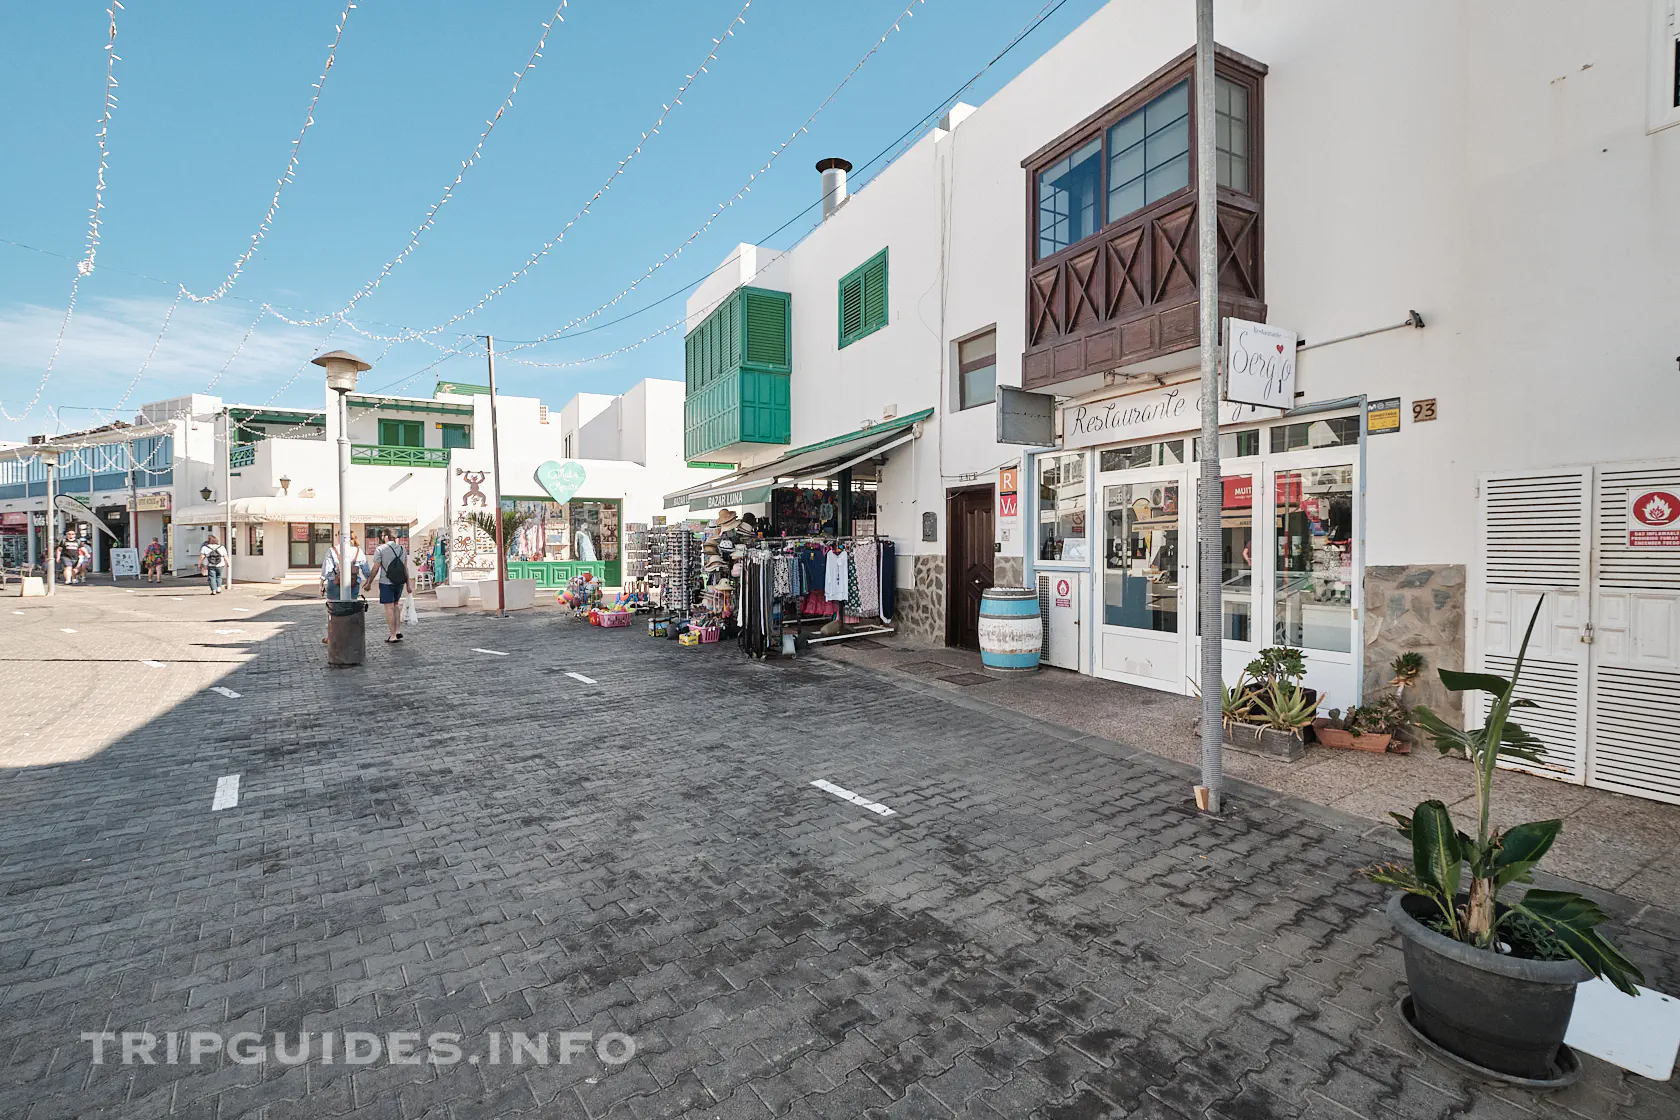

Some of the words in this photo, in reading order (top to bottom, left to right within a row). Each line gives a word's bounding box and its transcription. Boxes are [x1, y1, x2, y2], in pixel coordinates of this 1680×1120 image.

[1232, 331, 1292, 400] Sergio
[1071, 388, 1186, 436] Restaurante
[1412, 402, 1436, 419] 93
[1002, 472, 1013, 489] R
[673, 496, 686, 506] BAZAR
[707, 495, 726, 508] BAZAR
[726, 491, 743, 506] LUNA
